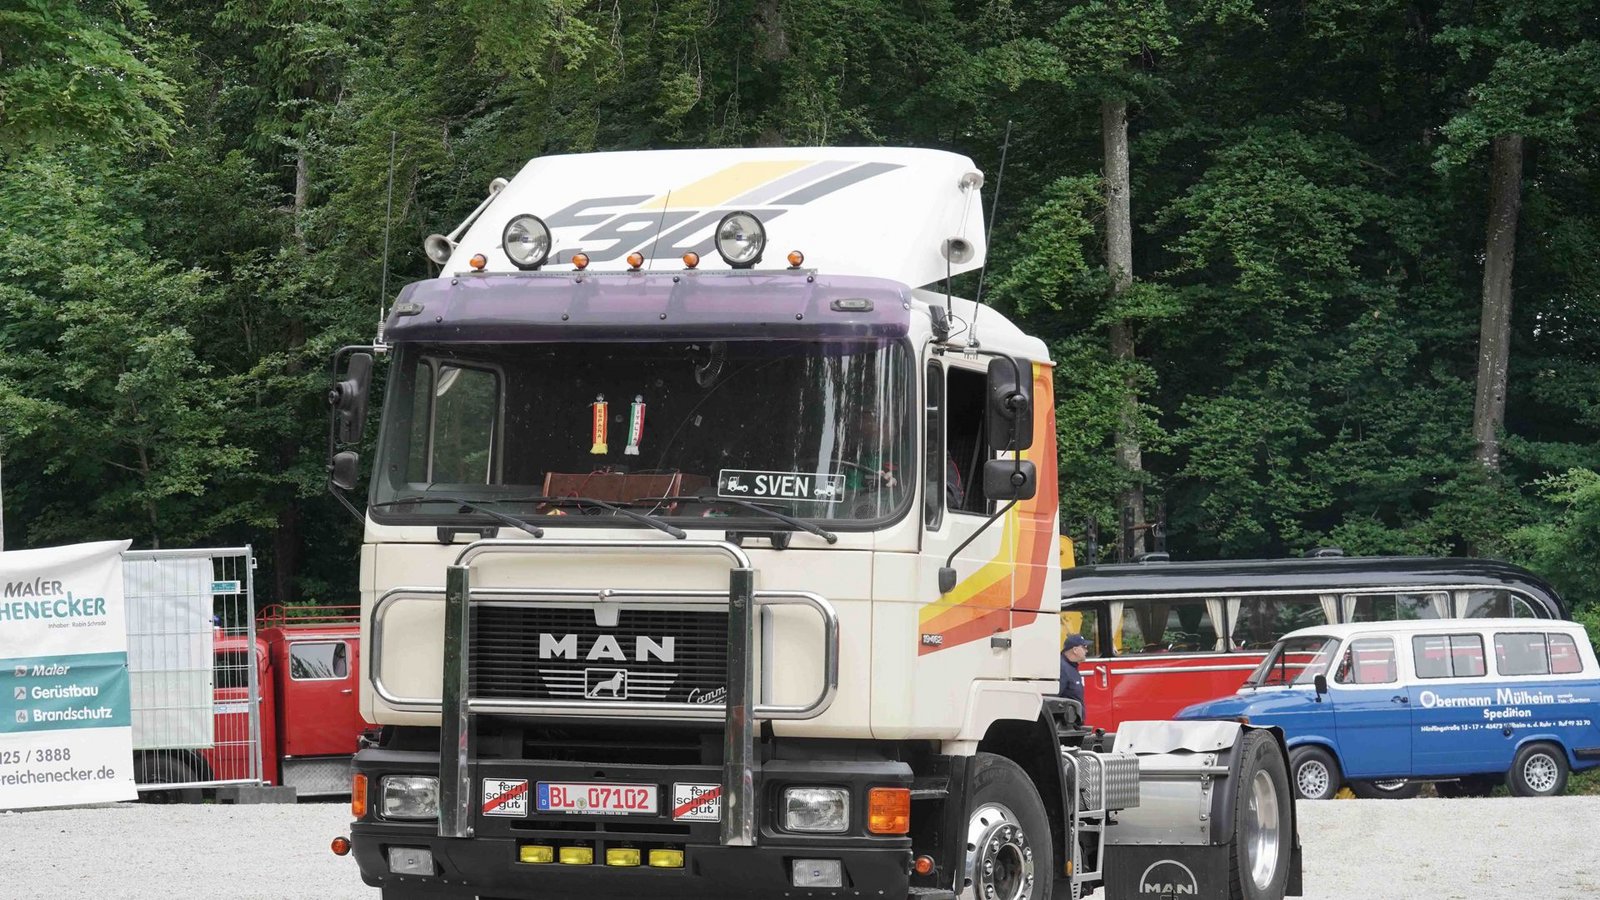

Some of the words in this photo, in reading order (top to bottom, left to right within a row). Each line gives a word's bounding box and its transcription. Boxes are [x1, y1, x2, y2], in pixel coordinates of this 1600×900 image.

[754, 474, 809, 497] SVEN
[539, 633, 675, 662] MAN
[31, 664, 71, 677] Maler
[31, 684, 99, 699] Gerüstbau
[1420, 691, 1491, 709] Obermann
[1497, 688, 1555, 705] Mülheim
[33, 706, 113, 722] Brandschutz
[1483, 708, 1532, 721] Spedition
[36, 748, 71, 762] 3888
[0, 765, 115, 785] reichenecker.de
[498, 800, 520, 810] gut
[550, 786, 575, 808] BL
[588, 787, 649, 810] 07102
[690, 805, 714, 815] gut
[1144, 883, 1193, 895] MAN
